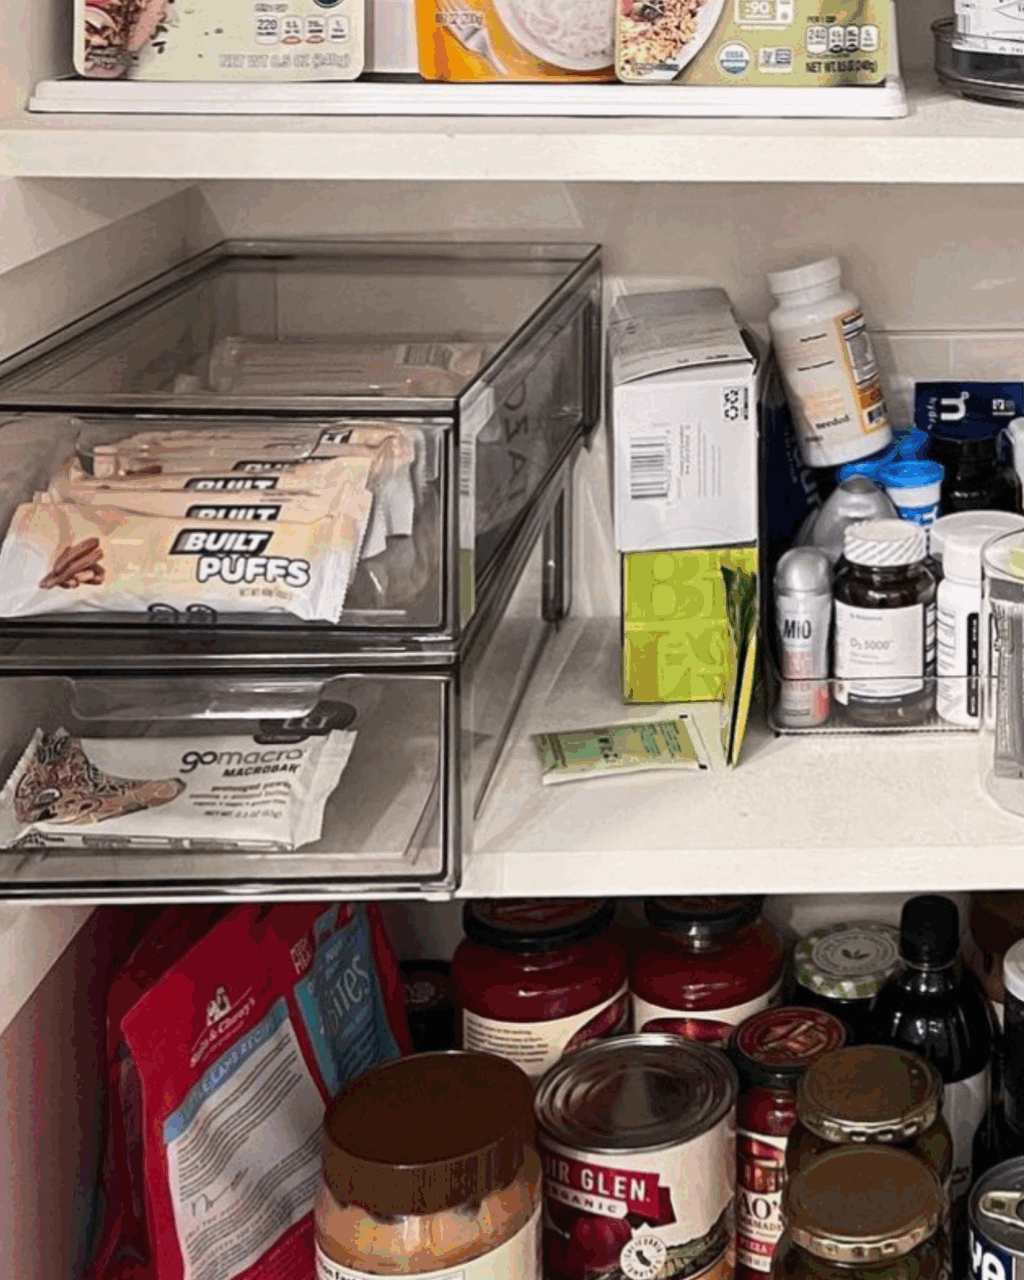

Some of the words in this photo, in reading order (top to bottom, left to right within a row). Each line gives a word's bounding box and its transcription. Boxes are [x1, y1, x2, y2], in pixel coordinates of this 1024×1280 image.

[183, 531, 270, 552] BUILT
[198, 556, 311, 588] PUFFS
[782, 619, 813, 640] MiO
[180, 747, 305, 775] gomacro
[222, 763, 303, 778] MACROBAR
[580, 1168, 646, 1202] GLEN
